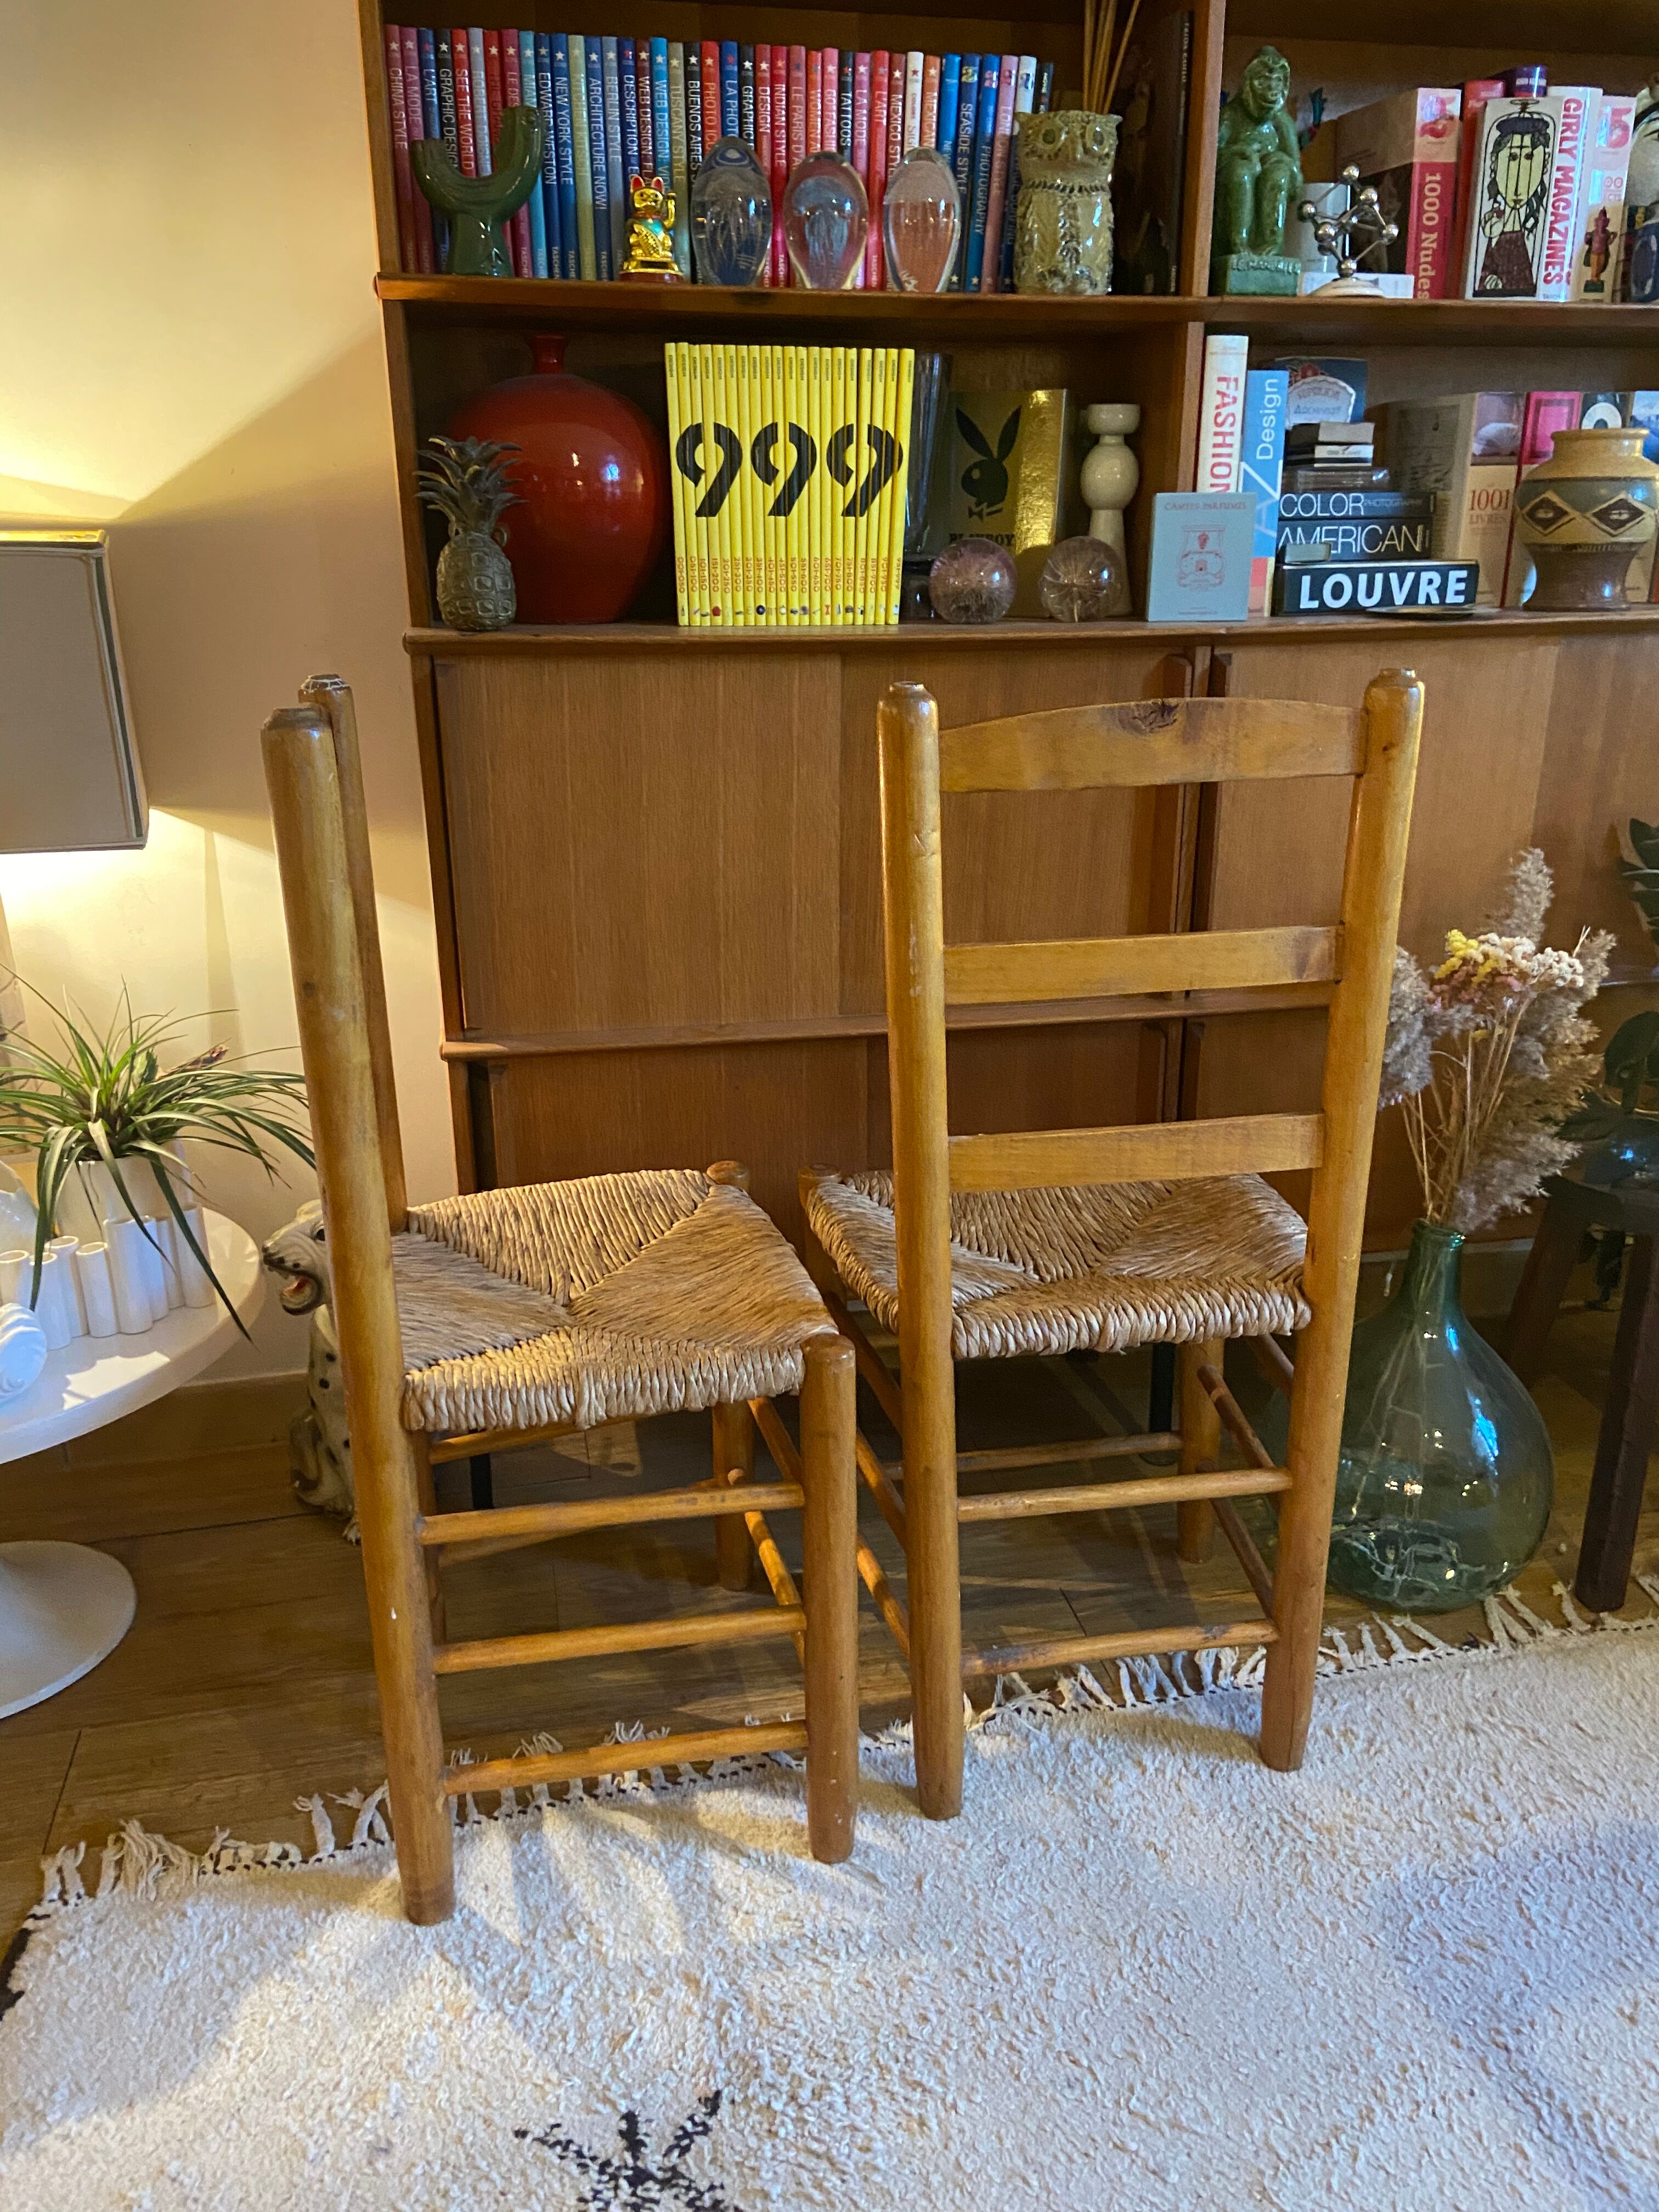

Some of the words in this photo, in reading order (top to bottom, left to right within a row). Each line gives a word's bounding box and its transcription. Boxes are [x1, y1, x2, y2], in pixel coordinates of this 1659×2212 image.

[390, 68, 404, 104] CHINA
[405, 66, 418, 82] LA
[424, 69, 437, 104] L'ART
[456, 69, 470, 93] SEE
[507, 72, 518, 86] LE
[555, 77, 568, 106] NEW
[639, 76, 651, 104] WEB
[725, 81, 737, 96] LA
[408, 87, 421, 125] MODE
[440, 69, 455, 122] GRAPHIC
[458, 95, 471, 120] THE
[473, 70, 487, 119] ROBERT
[538, 73, 554, 126] EDWARD
[606, 76, 619, 120] BERLIN
[655, 80, 667, 107] WEB
[670, 84, 683, 140] TUSCANY
[688, 81, 701, 131] BUENOS
[704, 82, 716, 125] PHOTO
[742, 86, 753, 139] GRAPHIC
[758, 86, 770, 132] DESIGN
[775, 84, 786, 126] INDIAN
[792, 87, 804, 100] LE
[856, 89, 867, 105] LA
[874, 91, 887, 126] L'ART
[394, 111, 408, 149] STYLE
[557, 109, 571, 143] YORK
[589, 78, 606, 171] ARCHITECTURE
[624, 75, 637, 155] DESCRIPTION
[792, 105, 804, 140] PARIS
[809, 89, 822, 139] WOMEN
[840, 92, 852, 146] TATTOOS
[856, 110, 867, 146] MODE
[890, 94, 903, 142] MEXICO
[923, 92, 938, 148] MEXICAN
[958, 103, 973, 153] SEASIDE
[1558, 98, 1583, 159] GIRLY
[460, 124, 475, 170] WORLD
[544, 131, 557, 184] WESTON
[608, 125, 622, 163] STYLE
[690, 135, 702, 170] AIRES
[775, 129, 786, 167] STYLE
[560, 148, 573, 185] STYLE
[673, 146, 685, 181] STYLE
[956, 157, 968, 194] STYLE
[594, 176, 607, 210] NOW!
[974, 145, 991, 235] PHOTOGRAPHY
[1422, 173, 1442, 226] 1000
[1543, 166, 1576, 285] MAGAZINES
[552, 246, 561, 279] TASCHEN
[1417, 232, 1438, 299] Nudes
[1256, 379, 1281, 459] Design
[676, 422, 903, 517] 999
[1279, 493, 1364, 517] COLOR
[1469, 489, 1510, 510] 1001
[949, 533, 1014, 546] PBOY
[1278, 525, 1424, 553] AMERICAN
[1300, 570, 1468, 609] LOUVRE
